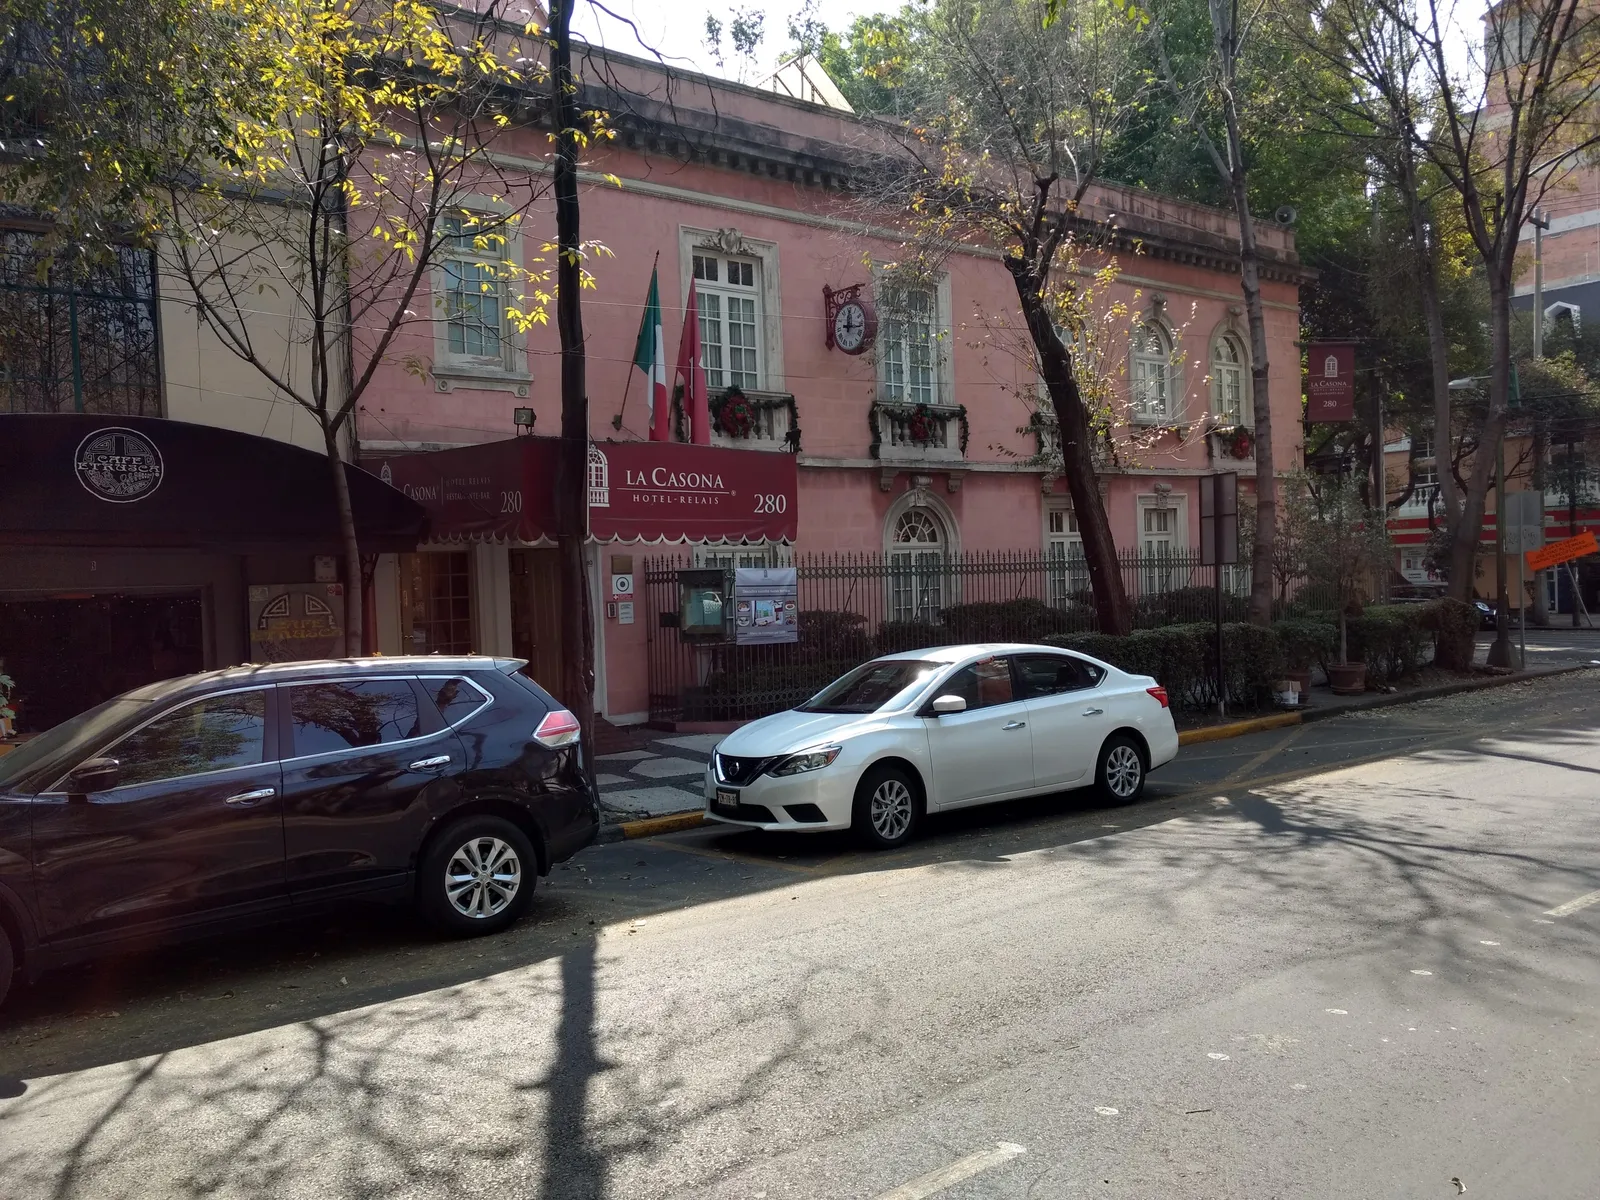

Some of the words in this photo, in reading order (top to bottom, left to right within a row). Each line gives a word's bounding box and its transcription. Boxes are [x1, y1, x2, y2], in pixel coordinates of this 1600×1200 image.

[1323, 400, 1337, 408] 280
[77, 462, 160, 473] ETRUSCA
[468, 476, 491, 485] RELAIS
[626, 469, 648, 486] LA
[651, 467, 725, 489] CASONA
[500, 490, 522, 513] 280
[633, 493, 719, 505] HOTEL-RELAIS
[753, 493, 787, 514] 280
